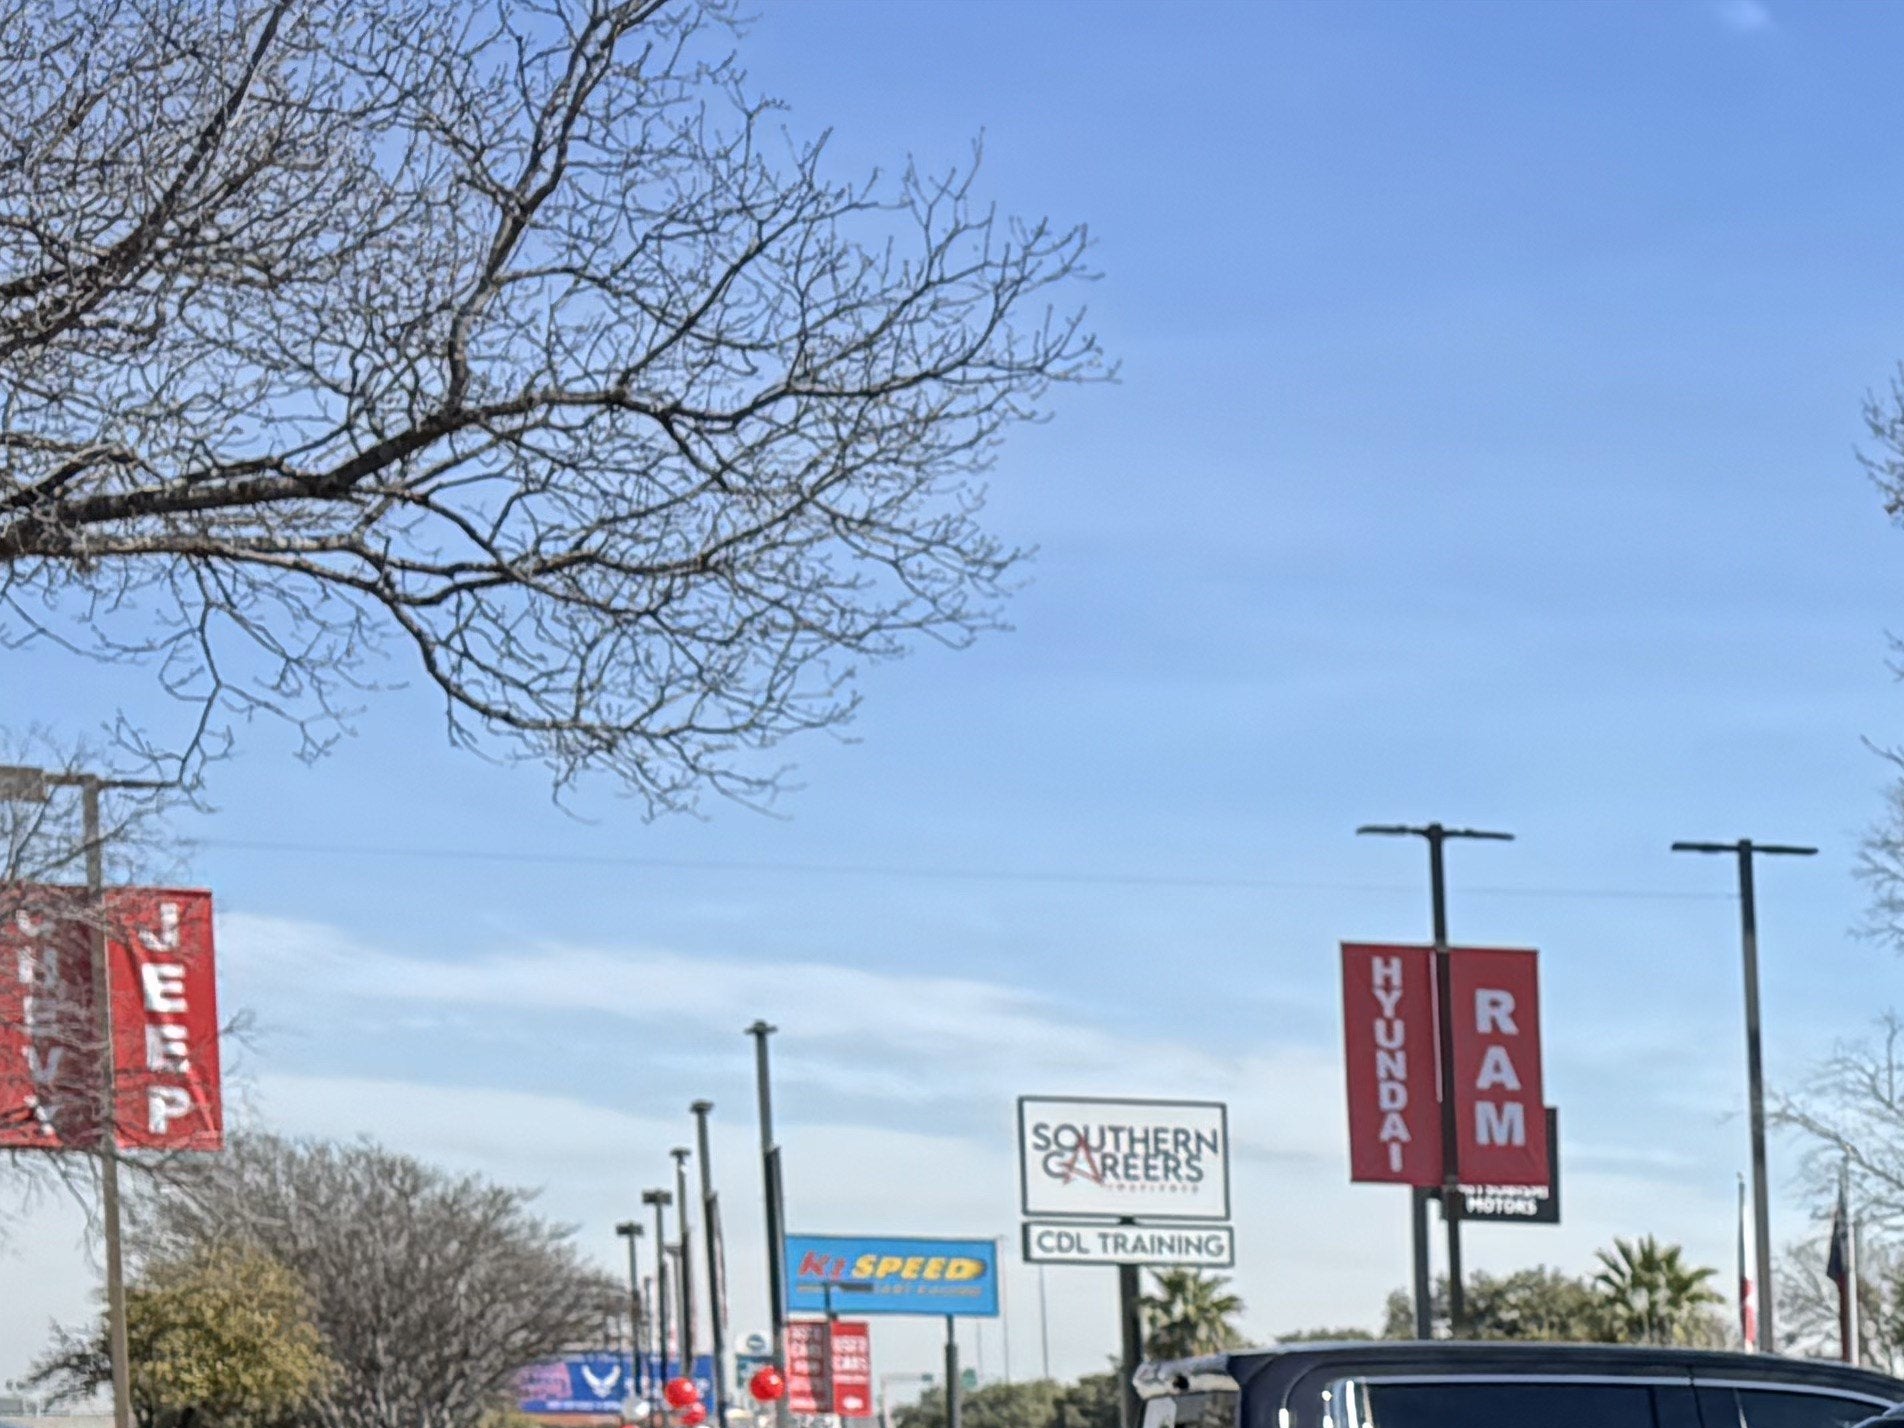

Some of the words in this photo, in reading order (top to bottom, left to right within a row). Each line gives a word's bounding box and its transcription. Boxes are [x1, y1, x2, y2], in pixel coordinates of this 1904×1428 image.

[138, 902, 195, 1134] JEEP
[1371, 956, 1412, 1173] HYUNDAI
[1474, 987, 1527, 1147] RAM
[1032, 1121, 1219, 1155] SOUTHERN
[1041, 1144, 1205, 1184] CAREERS
[1036, 1229, 1090, 1255] CDL
[1097, 1231, 1225, 1257] TRAINING
[851, 1254, 987, 1282] SPEED
